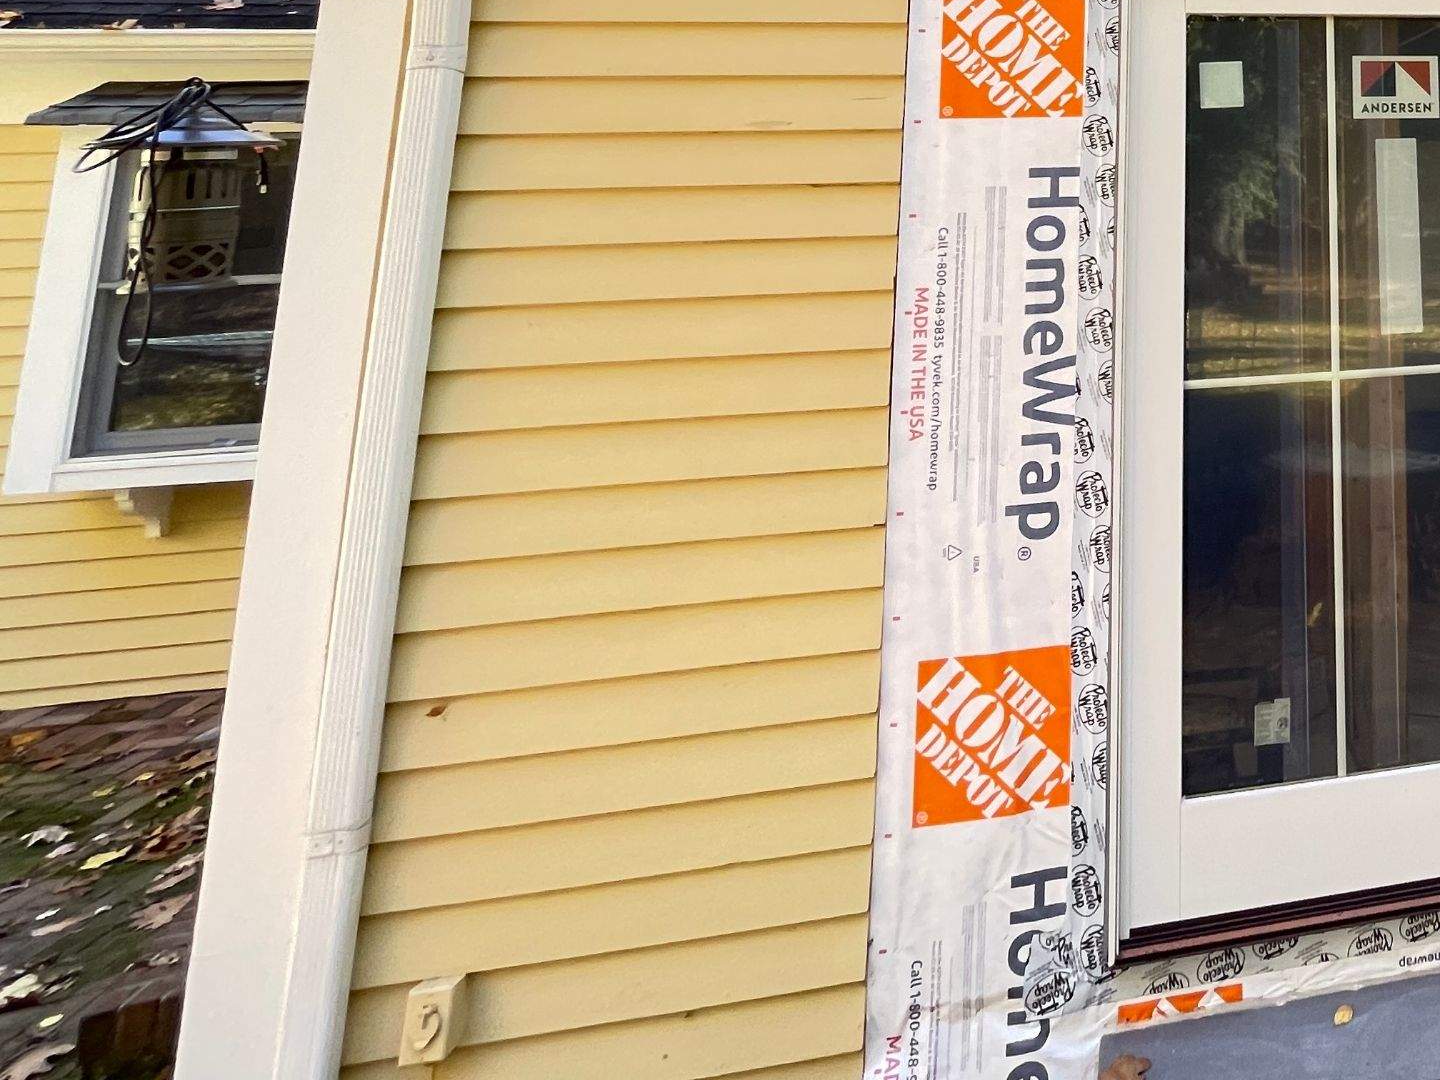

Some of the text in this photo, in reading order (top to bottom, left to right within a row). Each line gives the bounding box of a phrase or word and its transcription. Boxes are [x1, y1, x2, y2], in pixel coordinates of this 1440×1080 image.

[940, 39, 1036, 118] DEPOT
[1361, 102, 1433, 115] ANDERSEN
[907, 288, 930, 442] MADE IN THE USA
[929, 227, 950, 491] Call 1-800-448-9835 tyvek.com/homewrap
[1005, 166, 1081, 541] HomeWrap
[916, 657, 1070, 814] HOME
[997, 665, 1056, 727] THE
[916, 724, 1015, 820] DEPOT
[910, 960, 923, 989] Call
